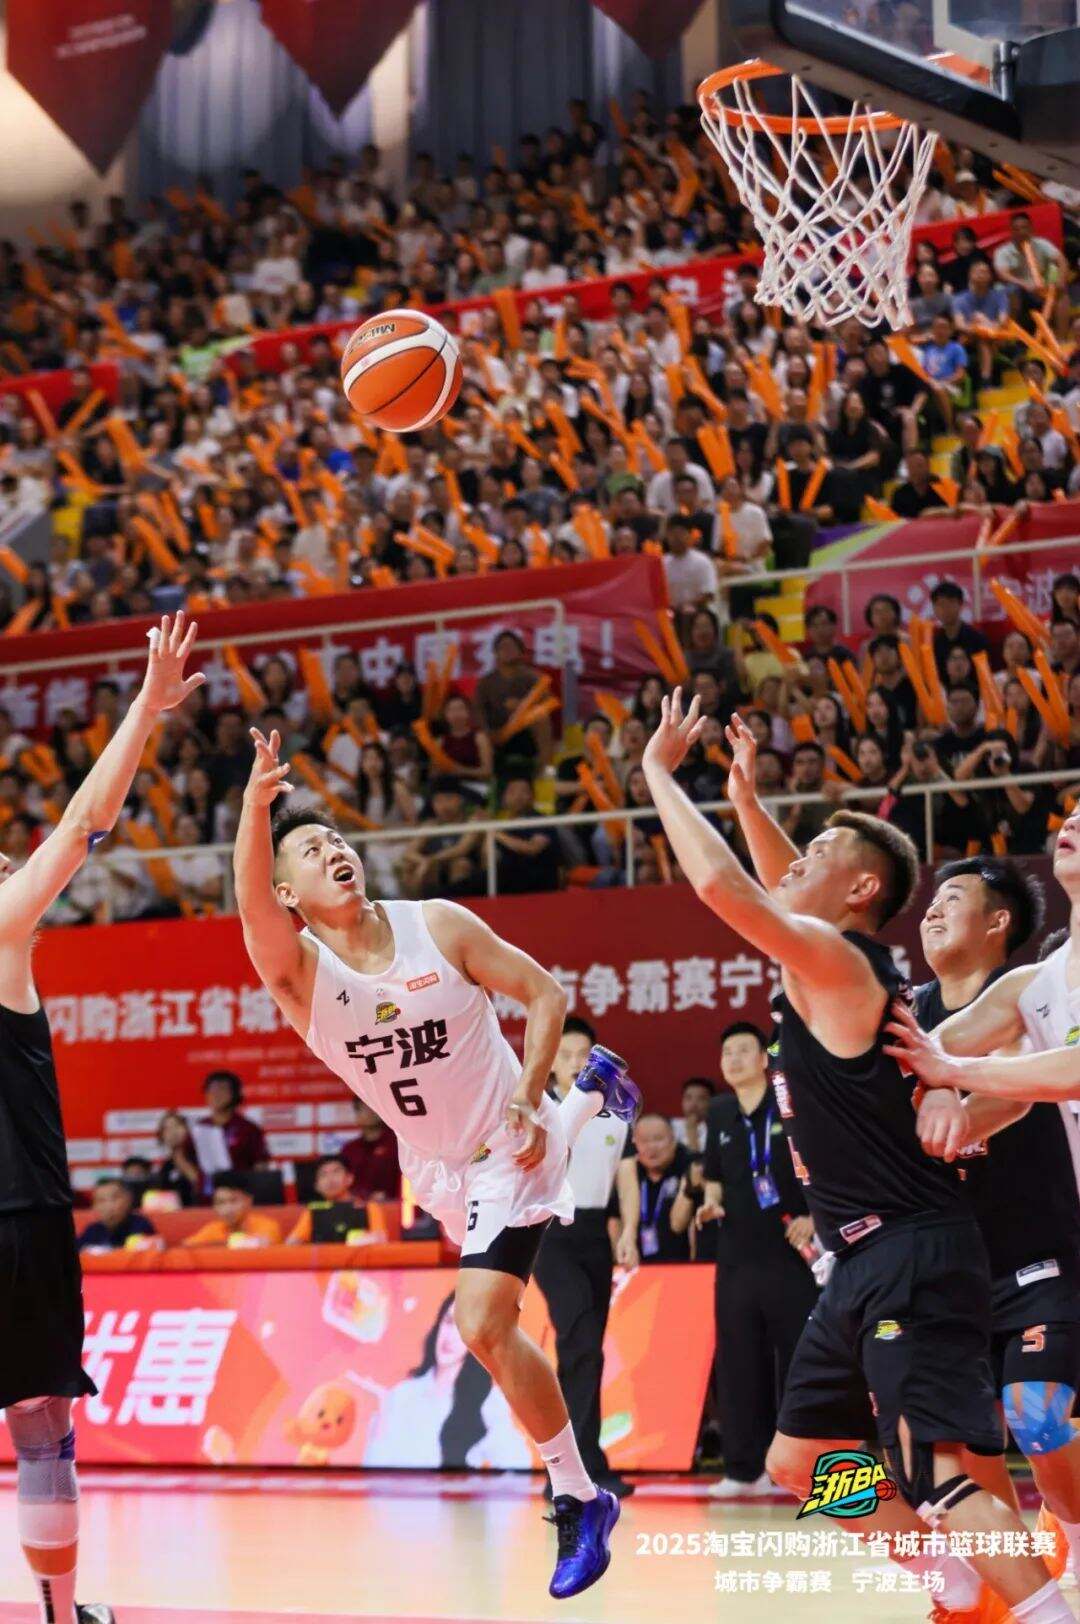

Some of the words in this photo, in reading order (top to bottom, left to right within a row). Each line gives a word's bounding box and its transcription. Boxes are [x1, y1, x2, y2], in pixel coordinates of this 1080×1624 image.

[44, 984, 290, 1044] 闪购浙江省城
[345, 1018, 450, 1074] 宁波
[389, 1077, 427, 1117] 6
[1021, 1323, 1048, 1354] 5
